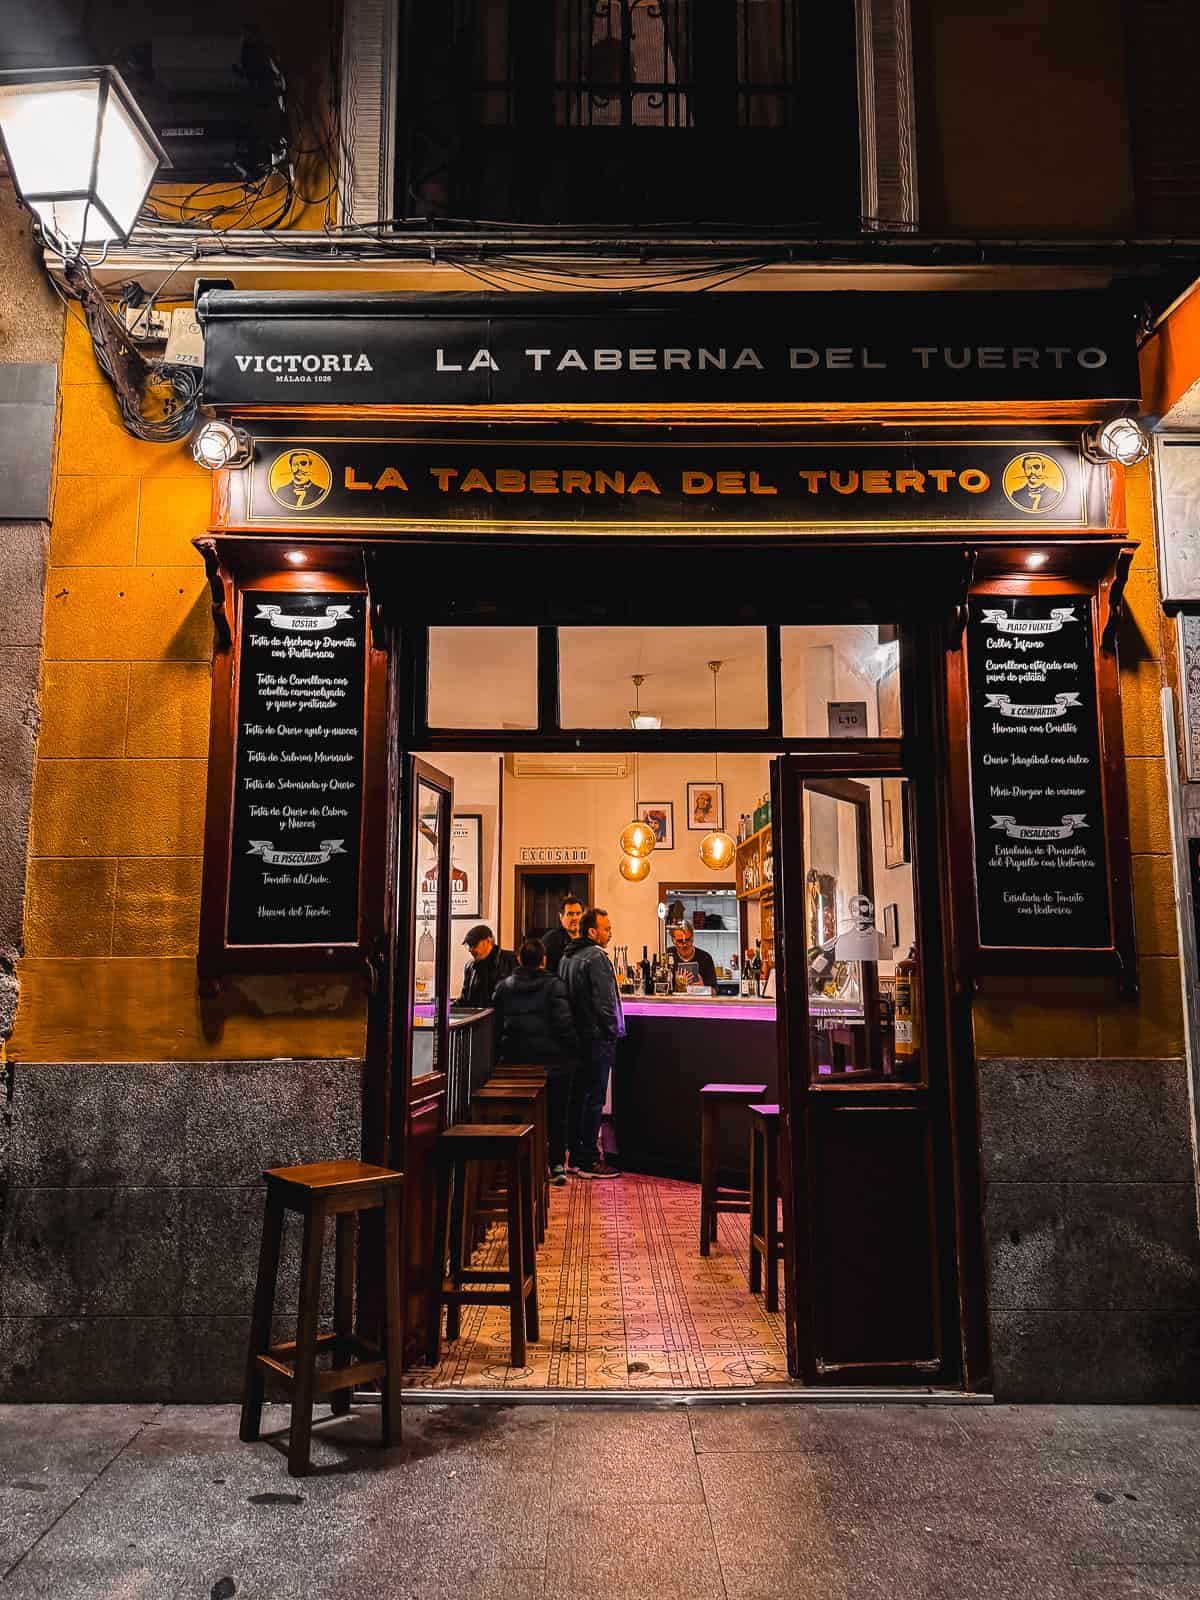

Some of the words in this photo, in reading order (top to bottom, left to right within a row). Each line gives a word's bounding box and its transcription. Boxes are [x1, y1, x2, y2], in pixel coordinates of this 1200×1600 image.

[234, 354, 373, 373] VICTORIA
[436, 349, 499, 371] LA
[525, 348, 764, 371] TABERNA
[789, 347, 887, 369] DEL
[911, 347, 1108, 369] TUERTO
[344, 466, 409, 491] LA
[430, 467, 661, 495] TABERNA
[681, 471, 777, 495] DEL
[799, 469, 991, 494] TUERTO
[521, 849, 588, 862] EXCUSADO
